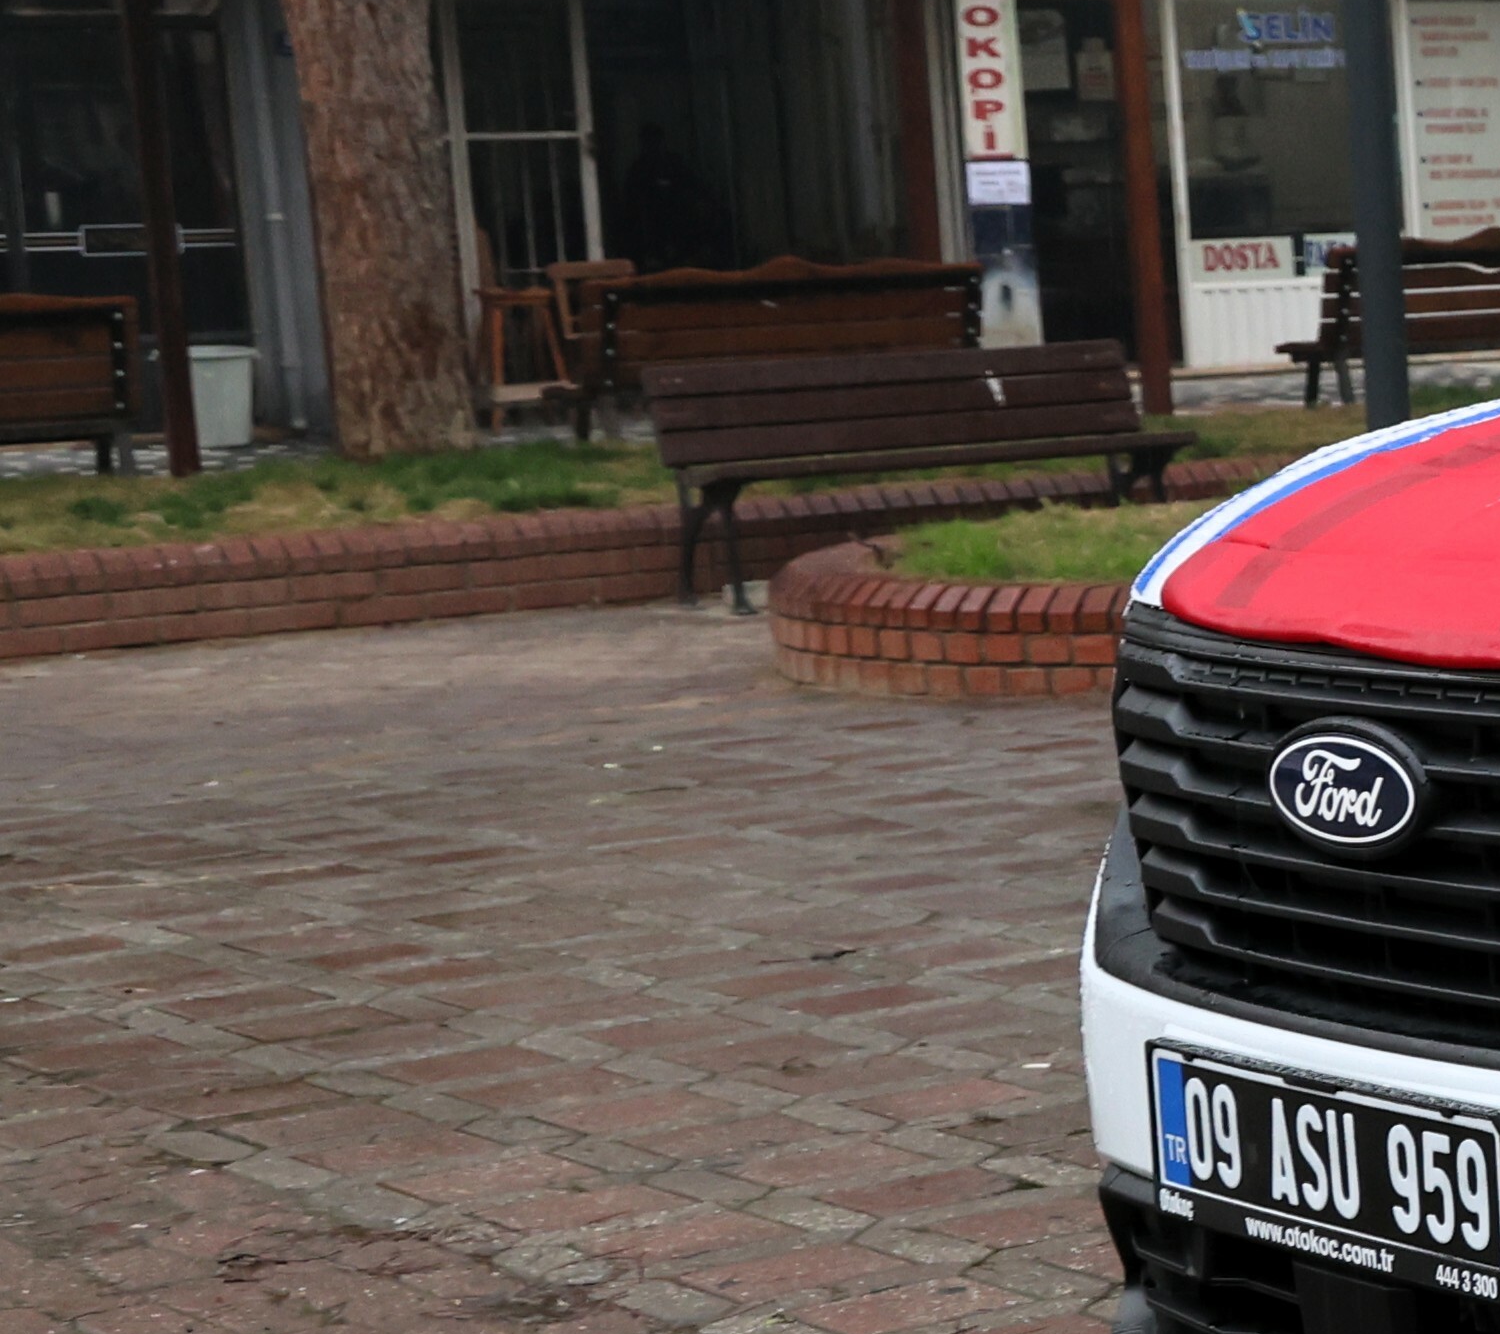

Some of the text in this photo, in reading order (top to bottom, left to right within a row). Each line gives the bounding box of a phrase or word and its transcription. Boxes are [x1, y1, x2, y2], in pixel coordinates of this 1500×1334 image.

[1242, 9, 1335, 42] SELİN
[1295, 749, 1384, 827] Ford
[1165, 1077, 1491, 1252] TR 09 ASU 959
[1245, 1217, 1395, 1274] www.otokoc.com.tr
[1435, 1264, 1498, 1300] 444 3 300
